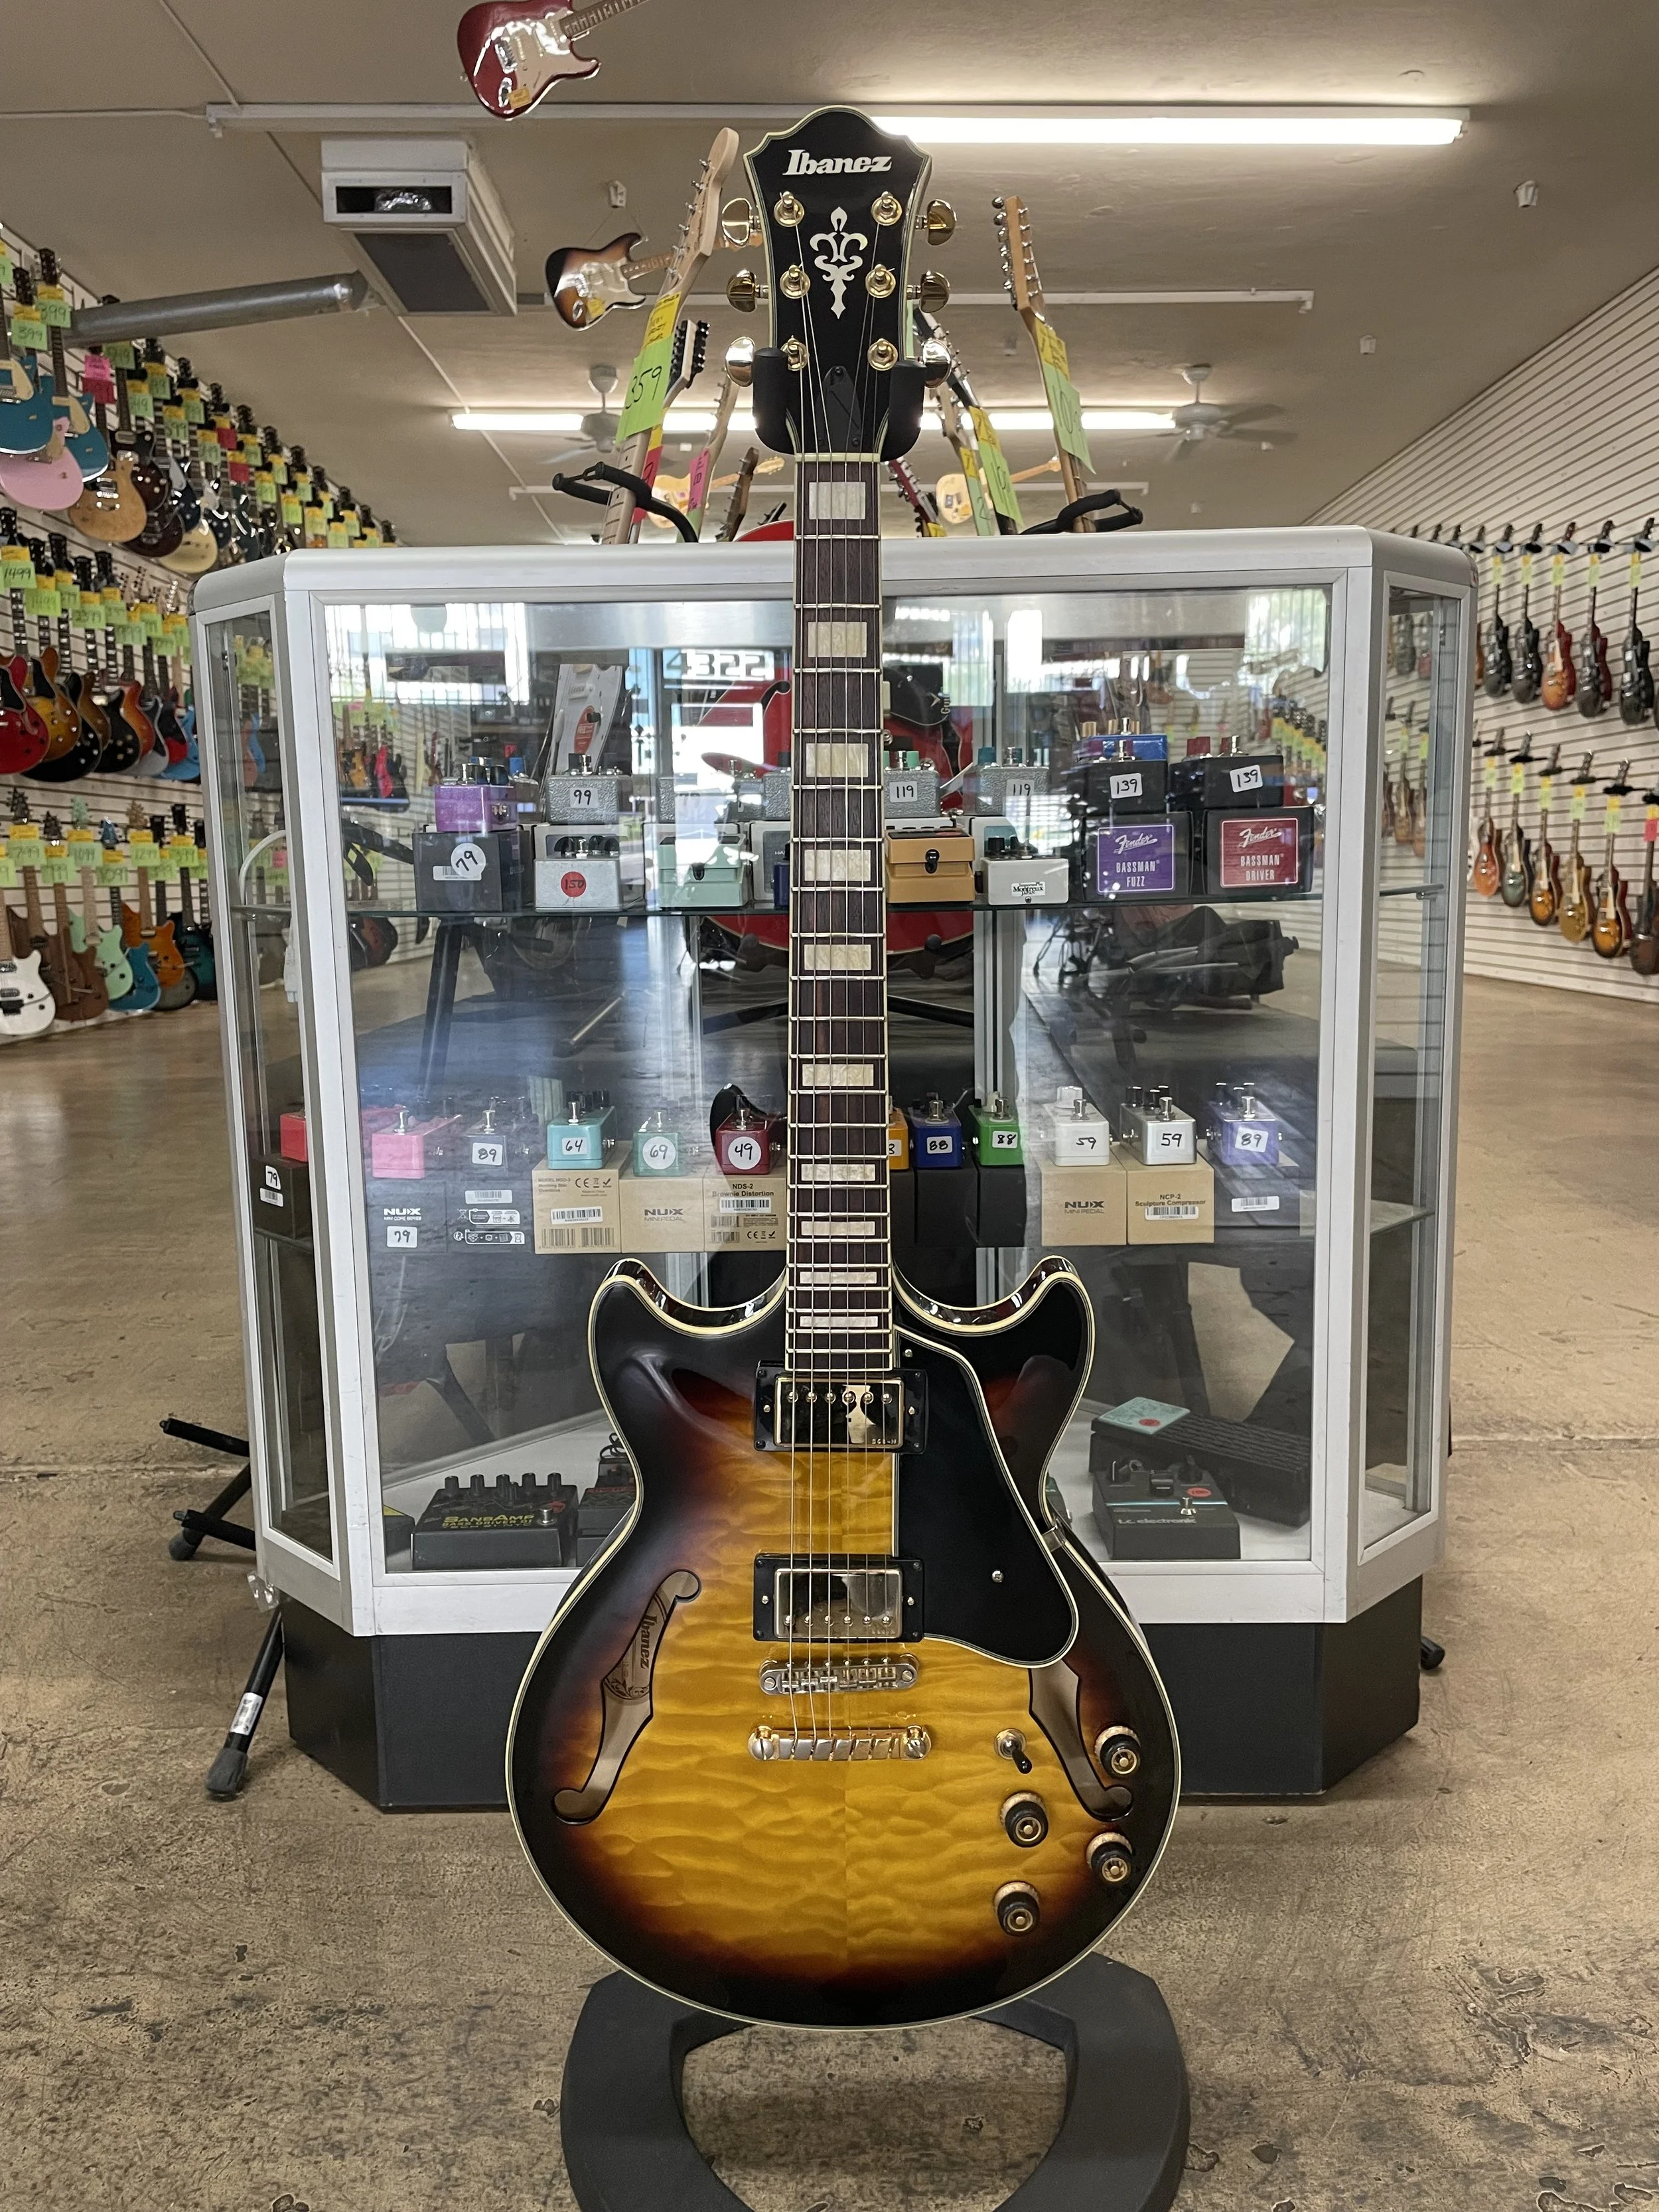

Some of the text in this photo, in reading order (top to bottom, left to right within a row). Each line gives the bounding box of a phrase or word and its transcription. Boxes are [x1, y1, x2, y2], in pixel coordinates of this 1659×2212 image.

[782, 149, 892, 176] Ibanez
[4, 566, 31, 580] 1499
[666, 652, 766, 678] 4322
[1238, 770, 1258, 788] 139
[896, 785, 914, 798] 119
[1013, 784, 1031, 796] 119
[1116, 778, 1138, 794] 139
[574, 789, 592, 805] 99
[1114, 833, 1157, 854] Fender
[1238, 826, 1282, 848] Fender
[455, 851, 478, 871] 79
[1116, 860, 1155, 873] BASSMAN
[1240, 855, 1280, 867] BASSMAN
[1127, 876, 1145, 887] FUZZ
[1246, 869, 1275, 881] DRIVER
[565, 879, 585, 890] 150
[929, 1140, 948, 1151] 88
[997, 1134, 1017, 1145] 88
[1076, 1137, 1097, 1149] 59
[1161, 1134, 1182, 1147] 59
[1241, 1134, 1262, 1147] 89
[565, 1140, 583, 1153] 64
[650, 1144, 668, 1160] 69
[735, 1143, 753, 1160] 49
[478, 1148, 497, 1162] 89
[267, 1171, 278, 1187] 79
[394, 1230, 411, 1243] 79
[640, 1614, 658, 1670] Ibanez
